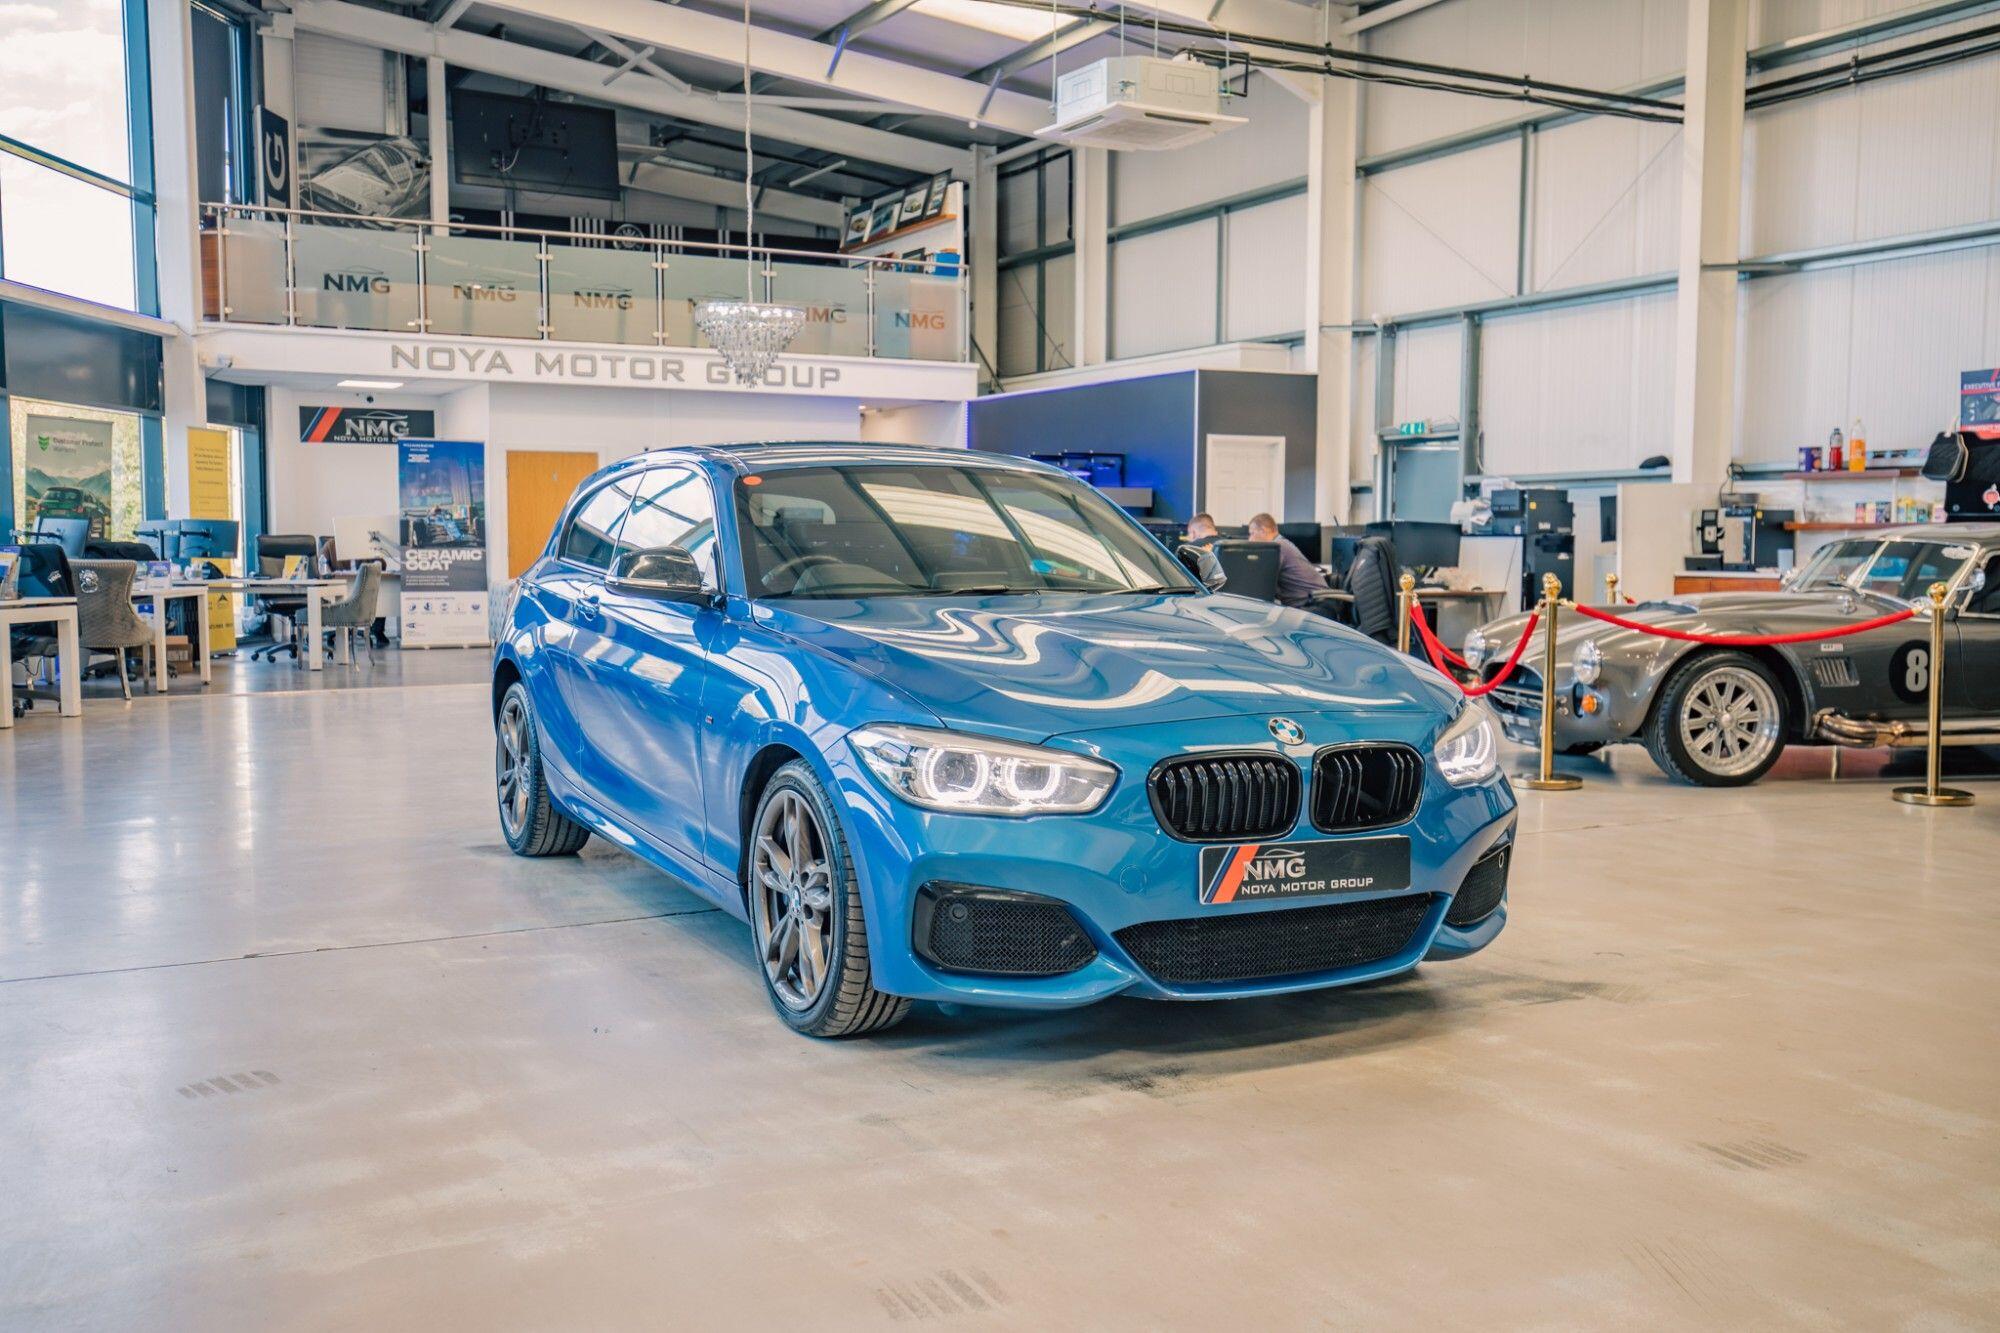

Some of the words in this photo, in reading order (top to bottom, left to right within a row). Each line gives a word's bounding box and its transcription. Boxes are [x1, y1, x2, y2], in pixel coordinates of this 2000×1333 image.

[323, 273, 391, 294] NMG
[453, 284, 516, 302] NMG
[574, 291, 633, 310] NMG
[894, 311, 945, 330] NMG
[391, 345, 513, 374] NOYA
[535, 352, 686, 382] MOTOR
[344, 418, 410, 437] NMG
[405, 549, 482, 561] CERAMIC
[405, 560, 453, 571] COAT
[1905, 648, 1929, 693] 8
[1242, 857, 1306, 882] NMG
[1241, 884, 1276, 896] NOYA
[1281, 879, 1326, 892] MOTOR
[1330, 877, 1374, 889] GROUP
